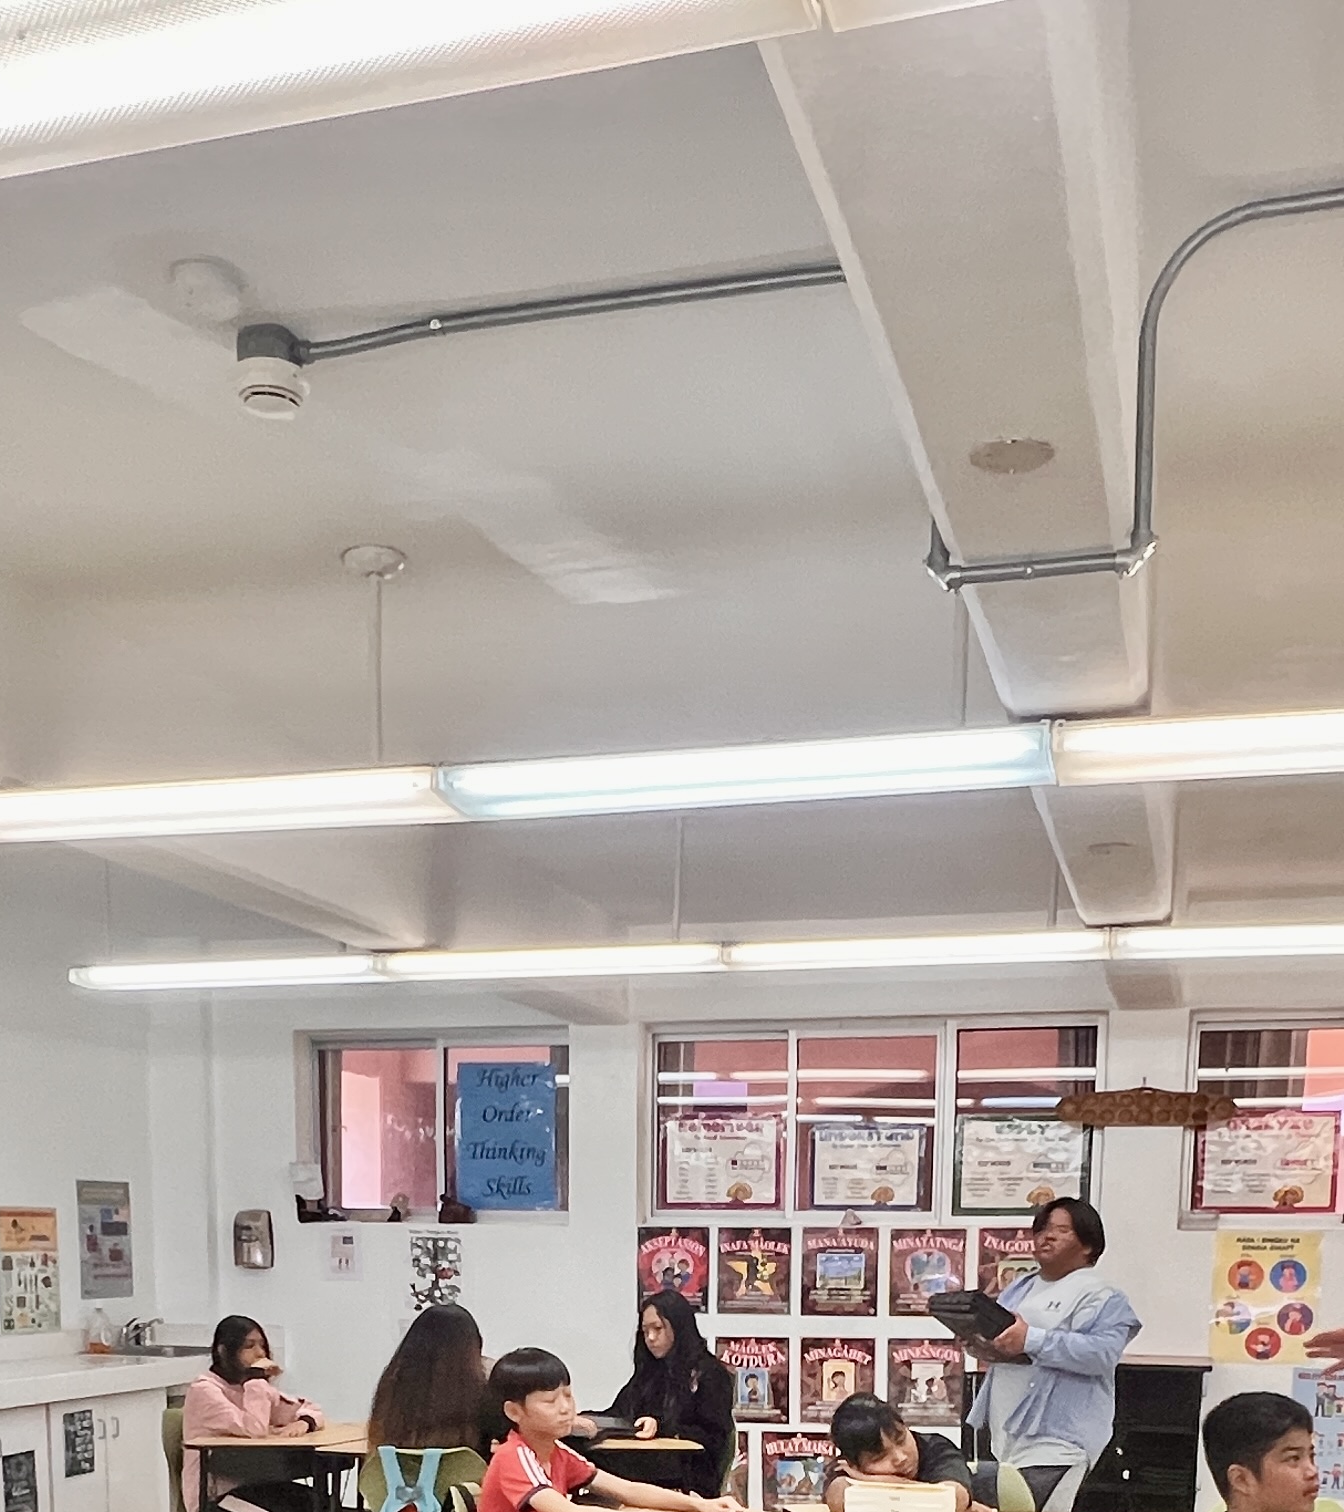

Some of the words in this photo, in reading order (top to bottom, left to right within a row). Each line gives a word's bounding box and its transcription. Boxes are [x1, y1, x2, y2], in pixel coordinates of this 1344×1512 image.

[476, 1067, 540, 1094] Higher
[482, 1103, 534, 1124] Order
[468, 1140, 547, 1167] Thinking
[482, 1174, 533, 1199] Skills
